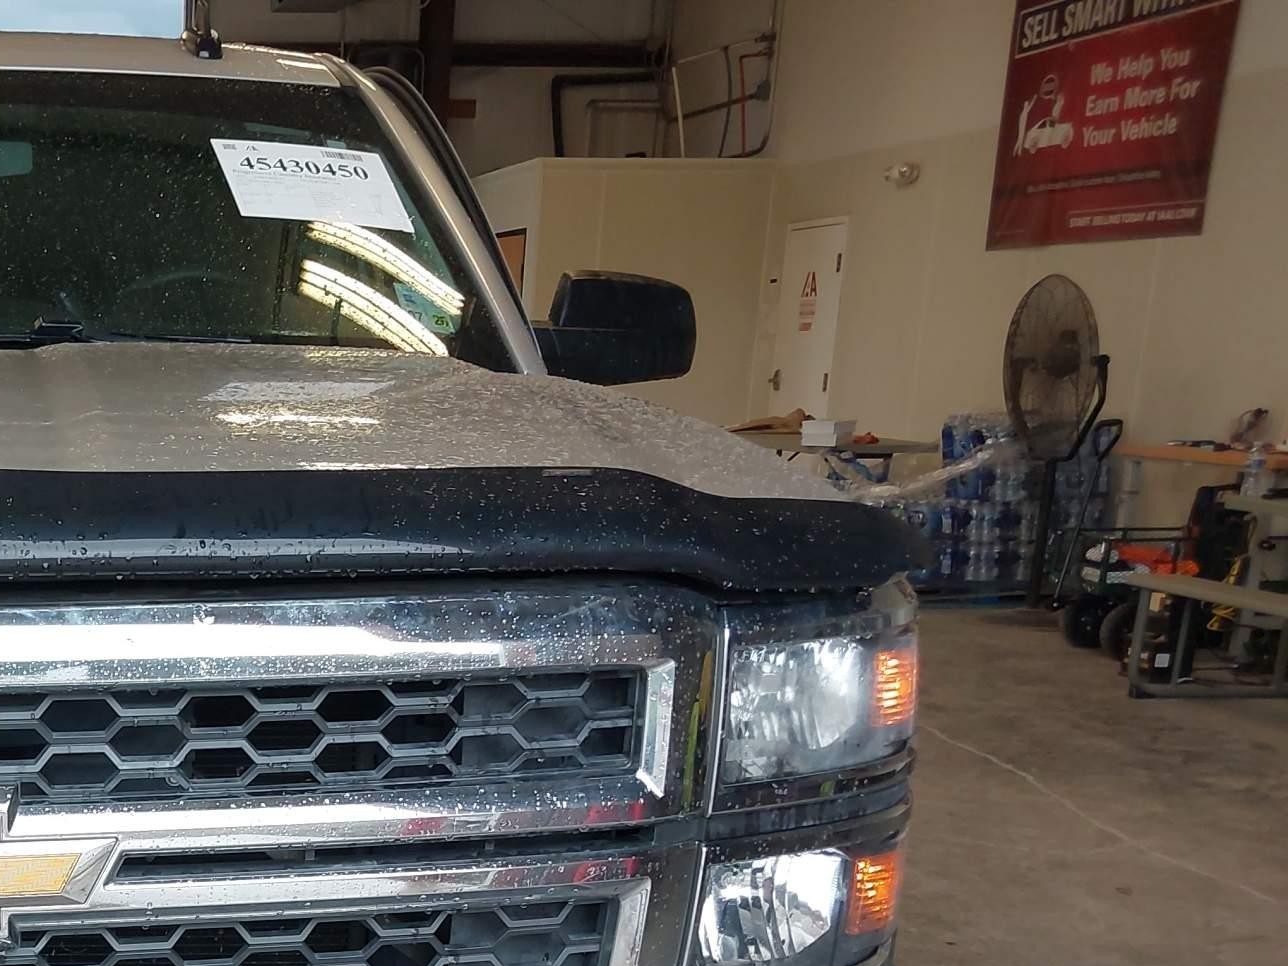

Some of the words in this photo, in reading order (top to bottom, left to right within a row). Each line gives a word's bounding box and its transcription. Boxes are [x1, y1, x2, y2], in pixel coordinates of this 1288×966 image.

[1022, 10, 1058, 48] SELL
[1062, 0, 1127, 37] SMART
[1090, 61, 1113, 86] We
[1117, 53, 1154, 80] Help
[1160, 47, 1191, 71] You
[1085, 95, 1119, 116] Earn
[1124, 86, 1166, 110] More
[1170, 77, 1201, 102] For
[1083, 126, 1116, 147] Your
[1121, 113, 1178, 142] Vehicle
[239, 156, 369, 181] 45430450
